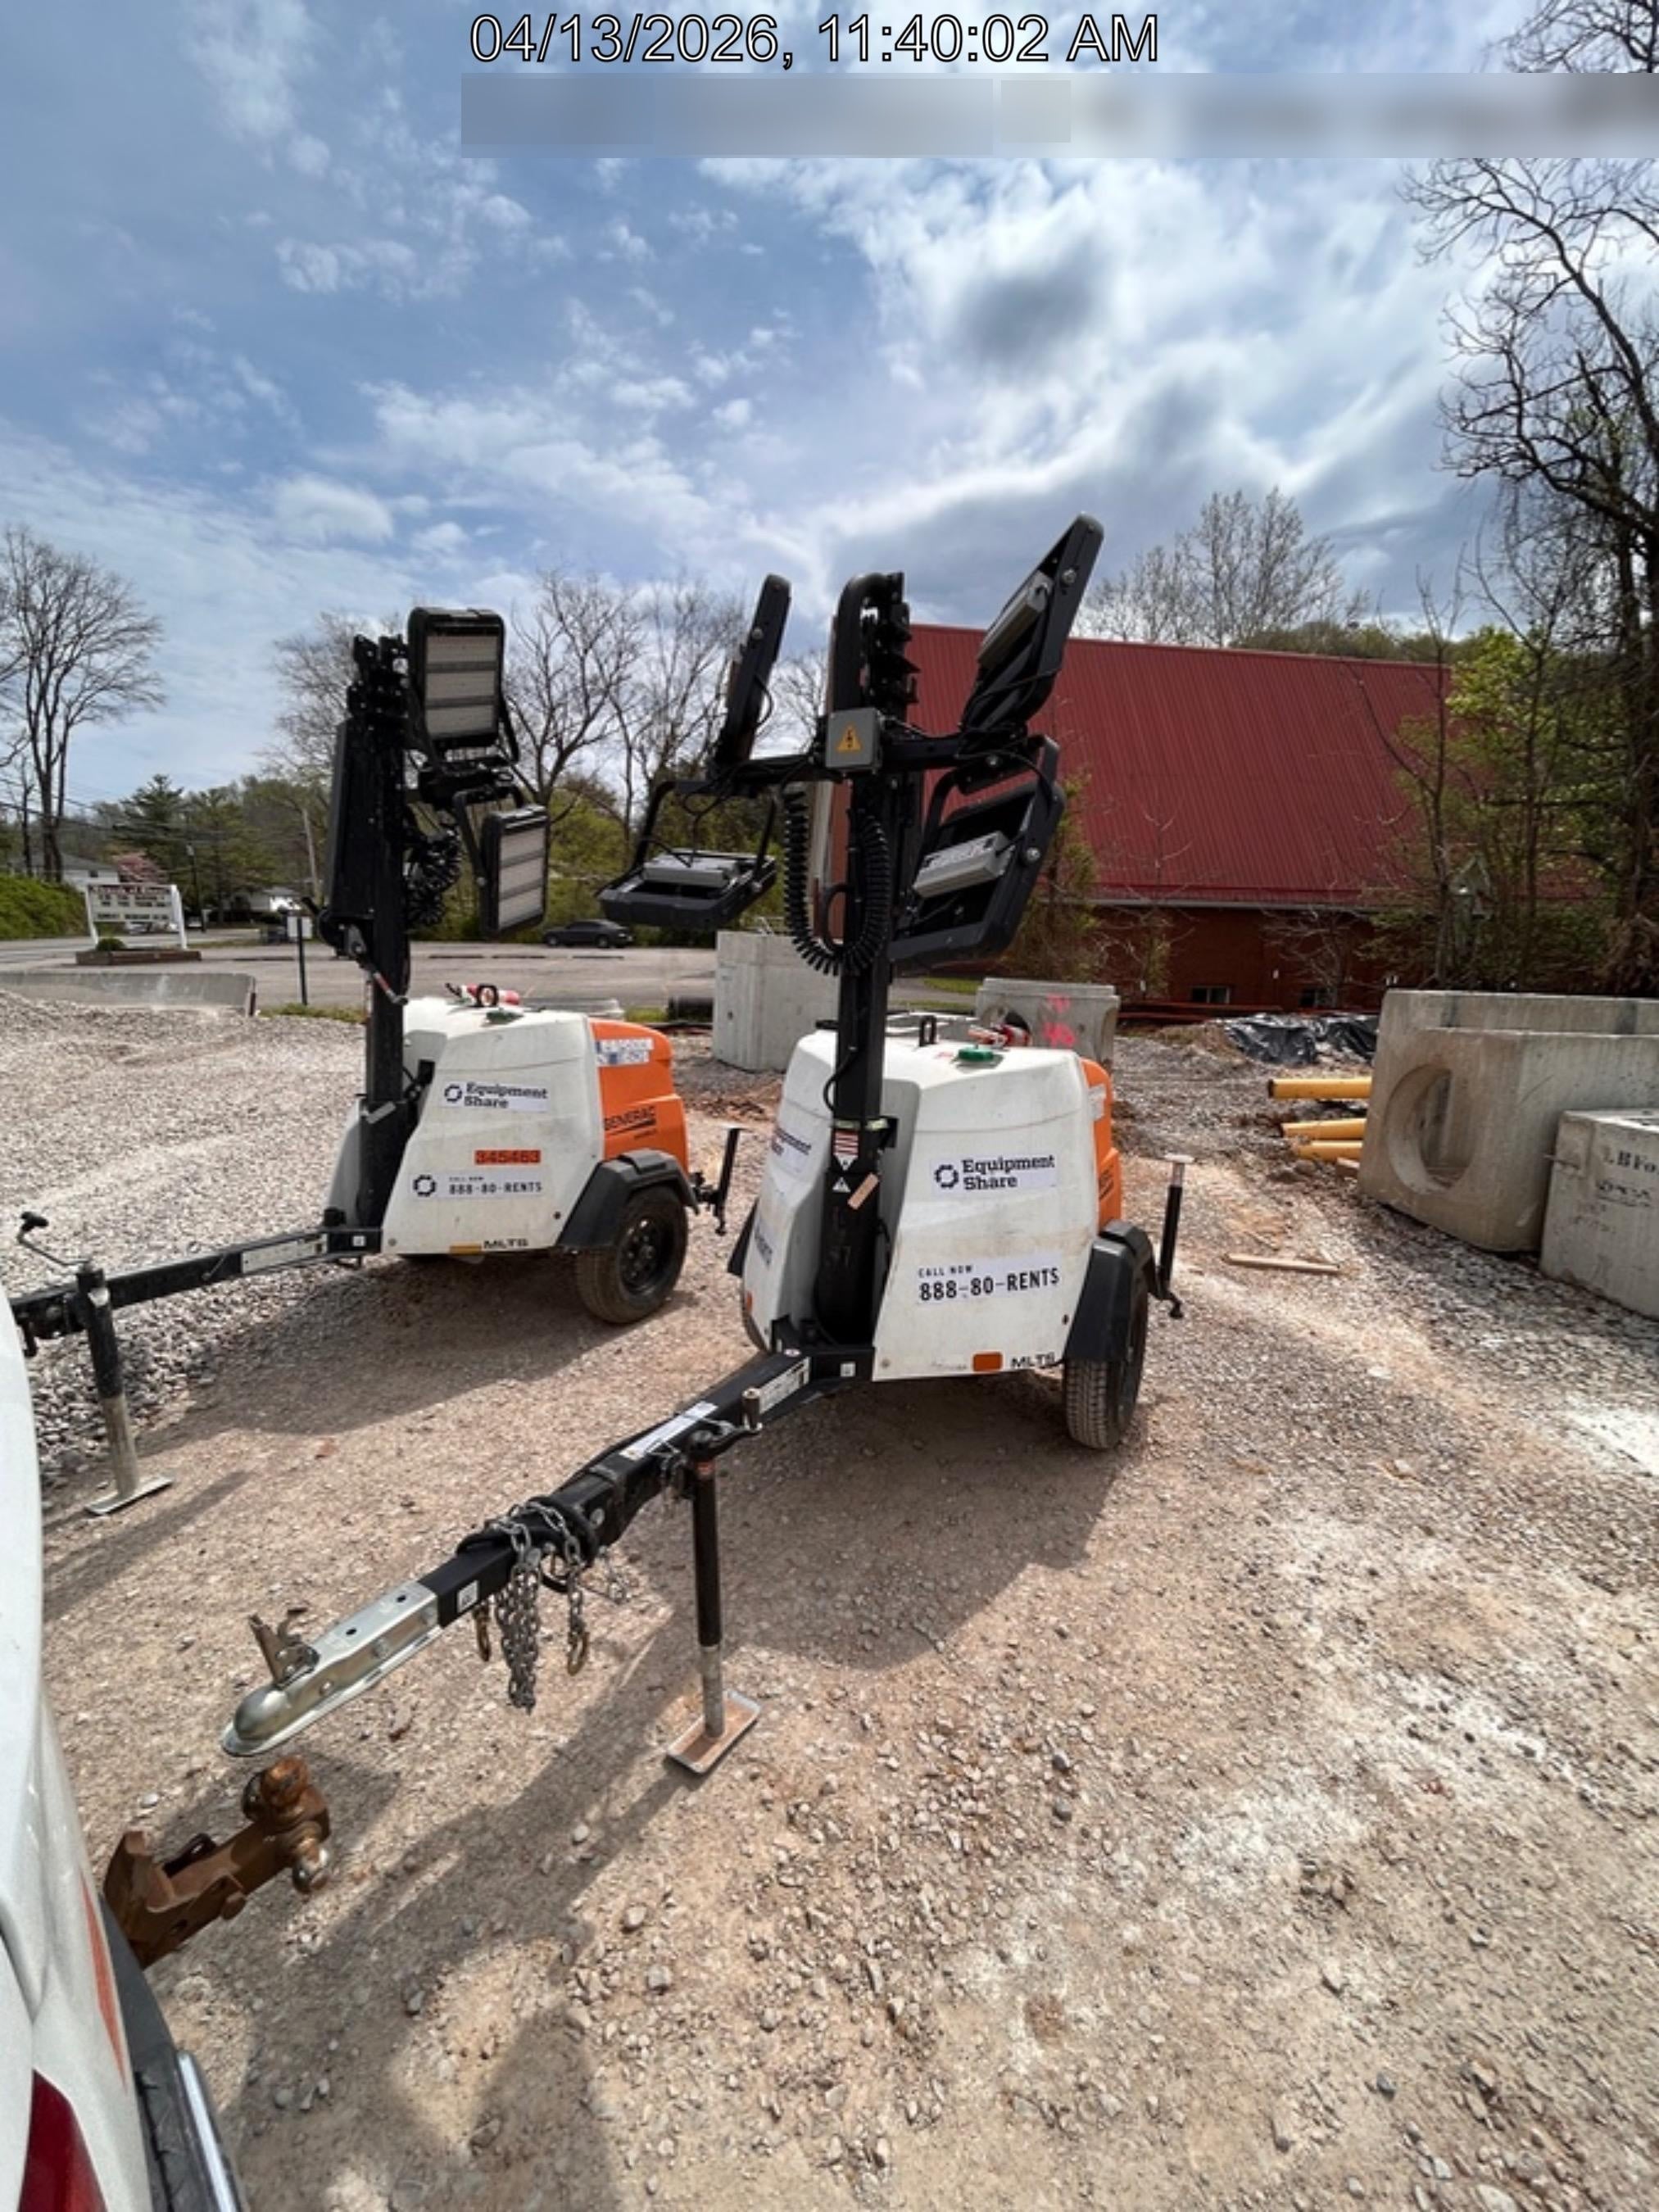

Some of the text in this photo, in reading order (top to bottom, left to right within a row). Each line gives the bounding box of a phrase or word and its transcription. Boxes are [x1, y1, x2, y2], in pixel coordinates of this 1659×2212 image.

[466, 1081, 547, 1099] Equipment
[464, 1095, 509, 1108] Share
[962, 1155, 1055, 1175] Equipment
[448, 1181, 542, 1195] 888-80-RENTS
[963, 1175, 1018, 1190] Share
[918, 1265, 973, 1278] CALL NOW
[919, 1267, 1059, 1301] 888-80-RENTS
